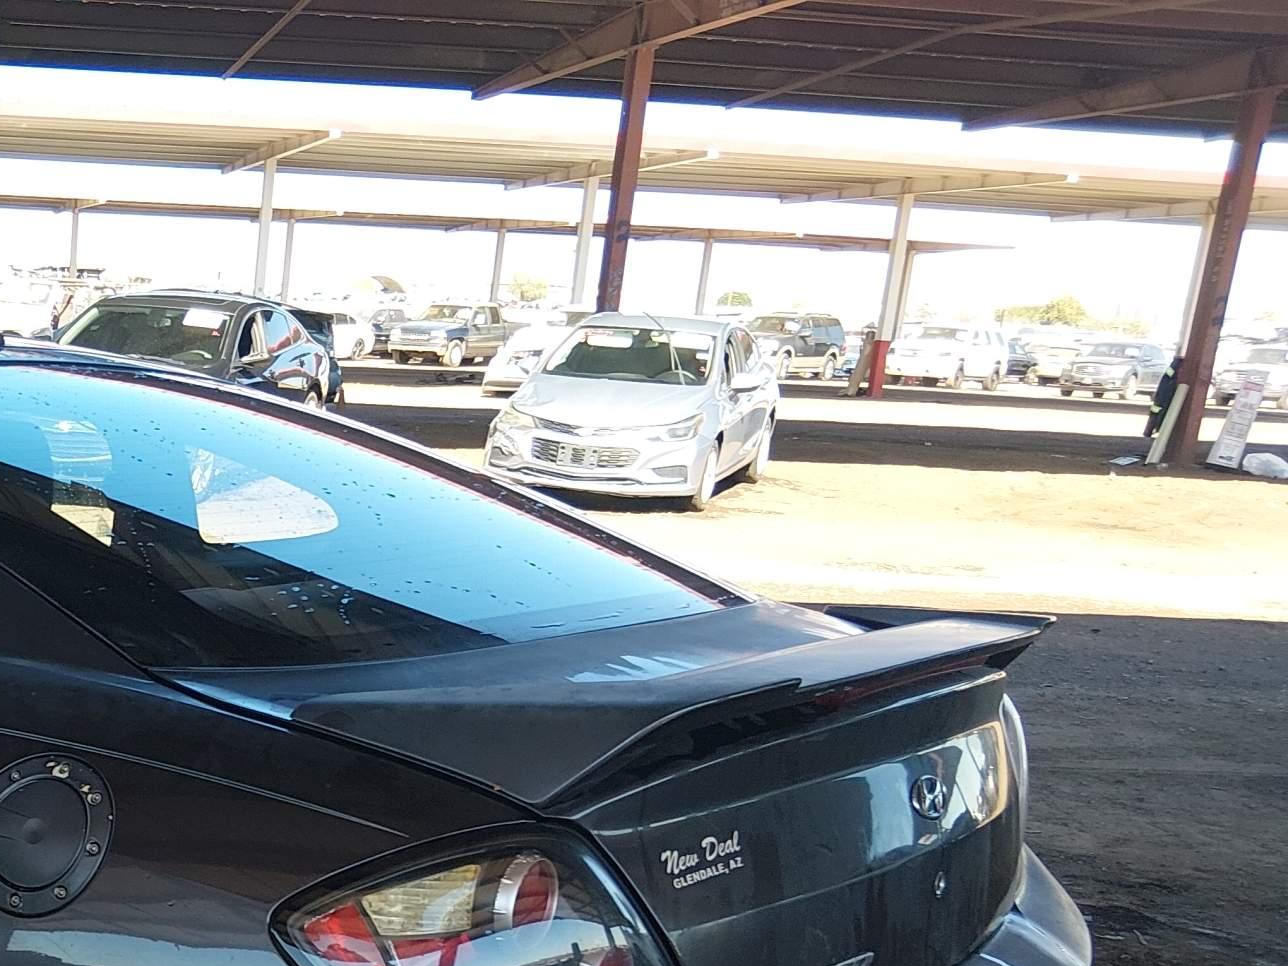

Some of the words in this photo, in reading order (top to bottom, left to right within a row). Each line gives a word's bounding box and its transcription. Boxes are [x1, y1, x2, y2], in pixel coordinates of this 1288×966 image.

[660, 850, 699, 875] New
[701, 830, 741, 861] Deal
[673, 863, 729, 889] GLENDALE,
[729, 857, 745, 870] AZ
